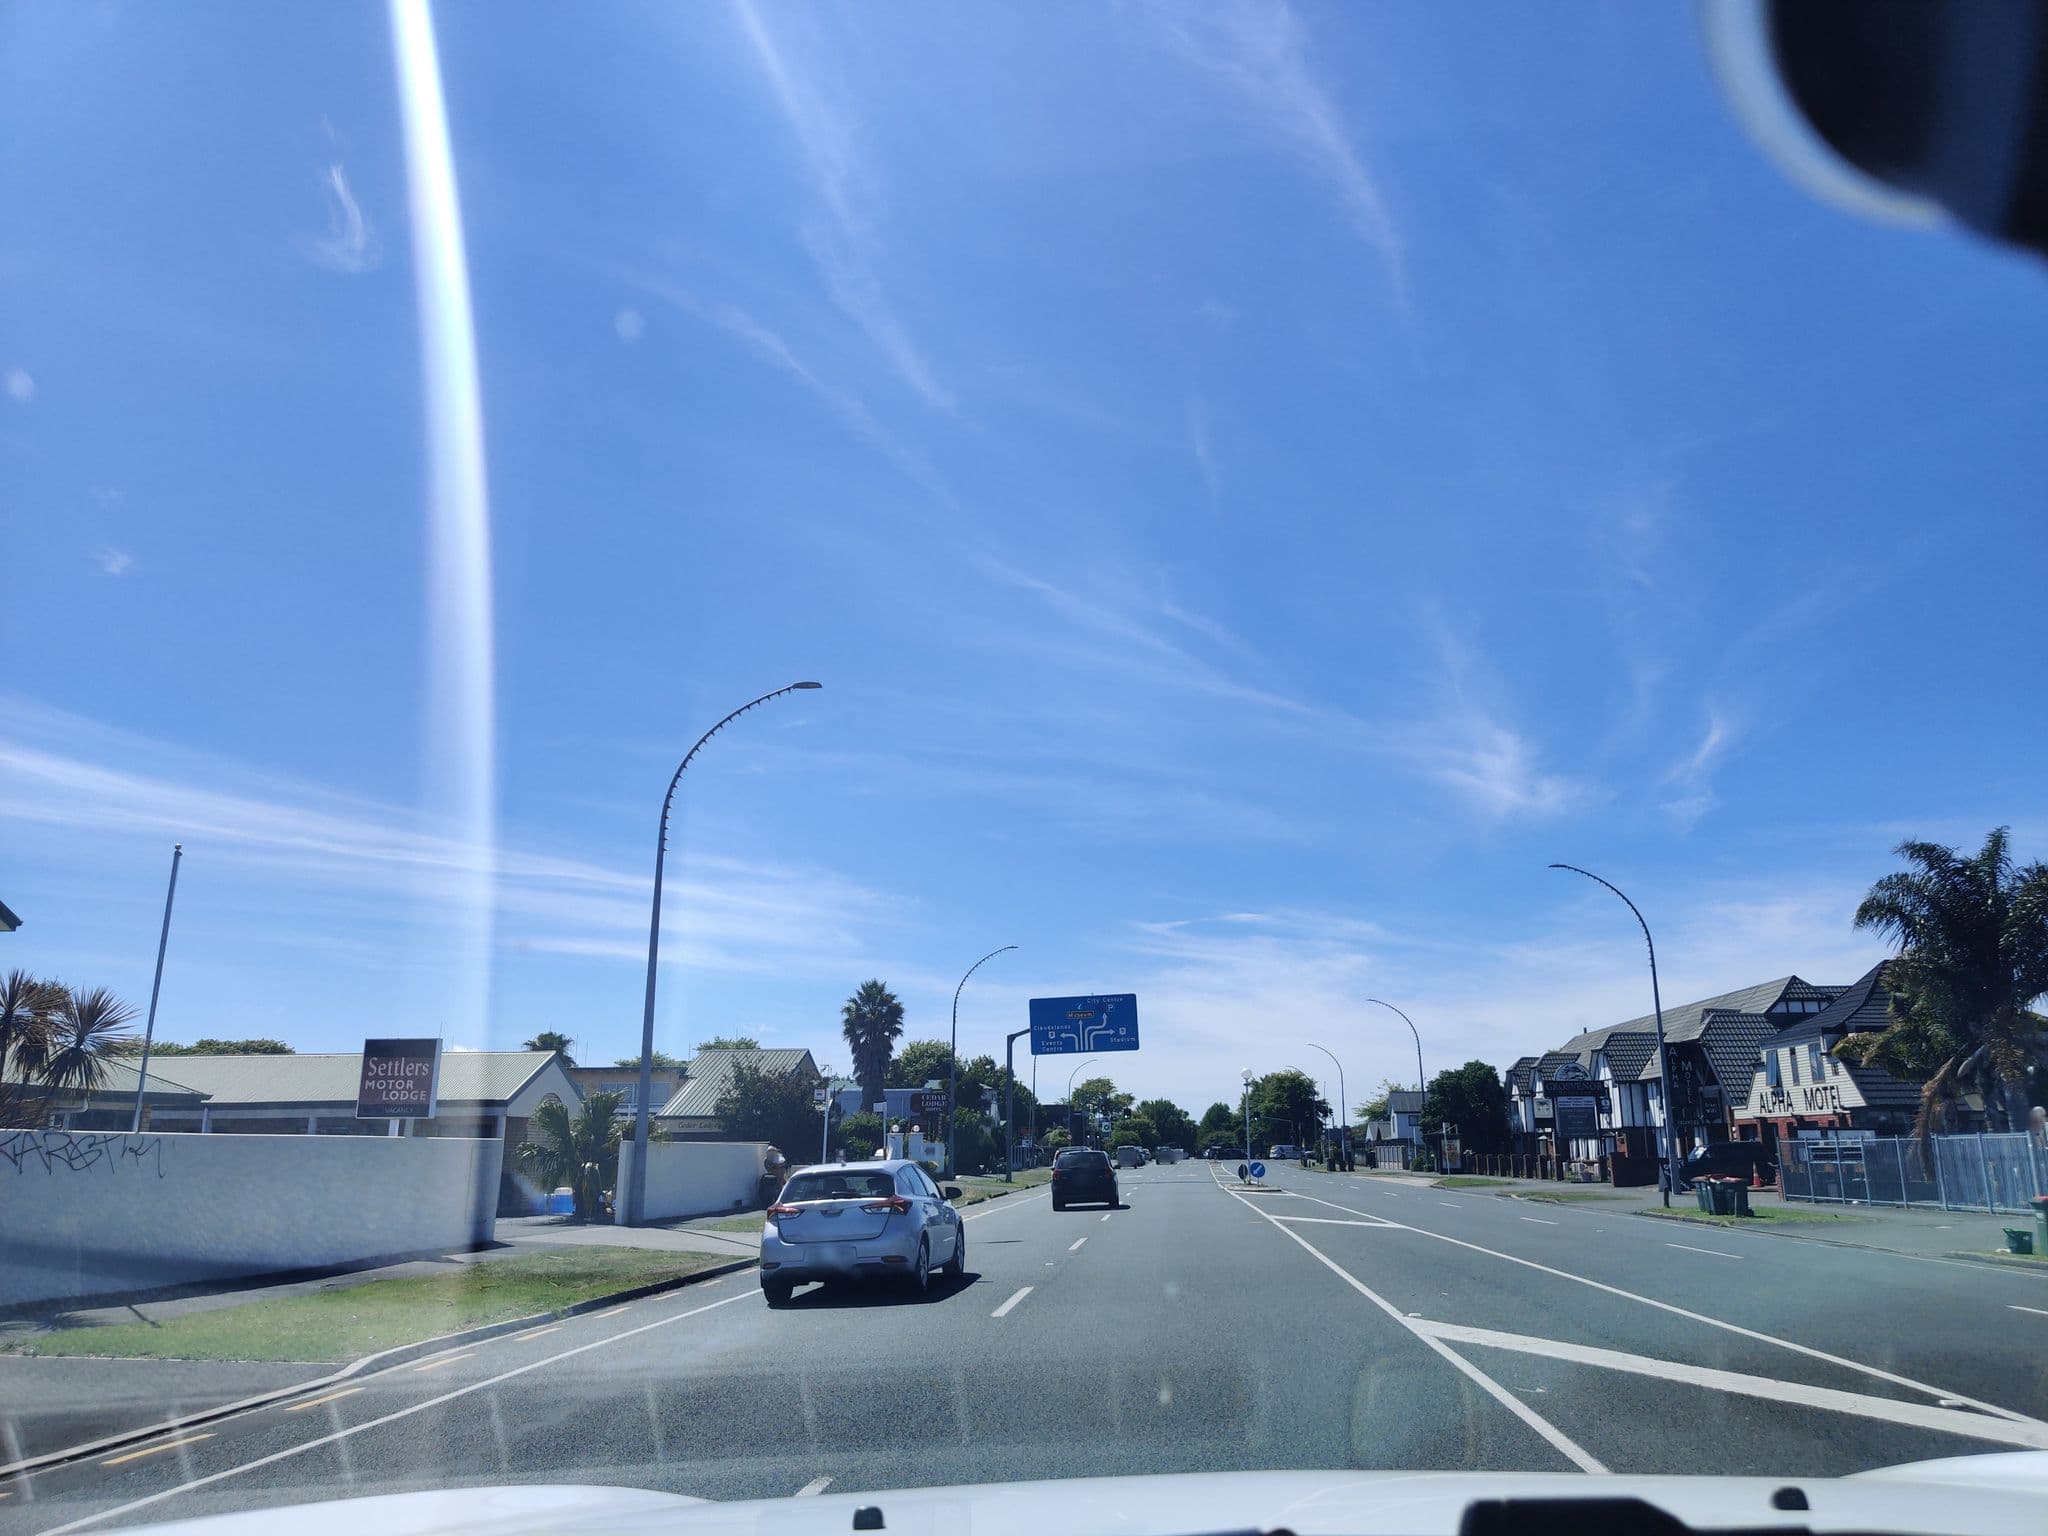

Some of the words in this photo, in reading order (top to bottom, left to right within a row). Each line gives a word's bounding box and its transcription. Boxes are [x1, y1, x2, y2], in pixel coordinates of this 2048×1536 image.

[367, 1057, 429, 1077] Settlers
[365, 1079, 414, 1090] MOTOR
[382, 1090, 427, 1101] LODGE
[1760, 1090, 1795, 1114] ALPHA
[1803, 1085, 1843, 1112] MOTEL
